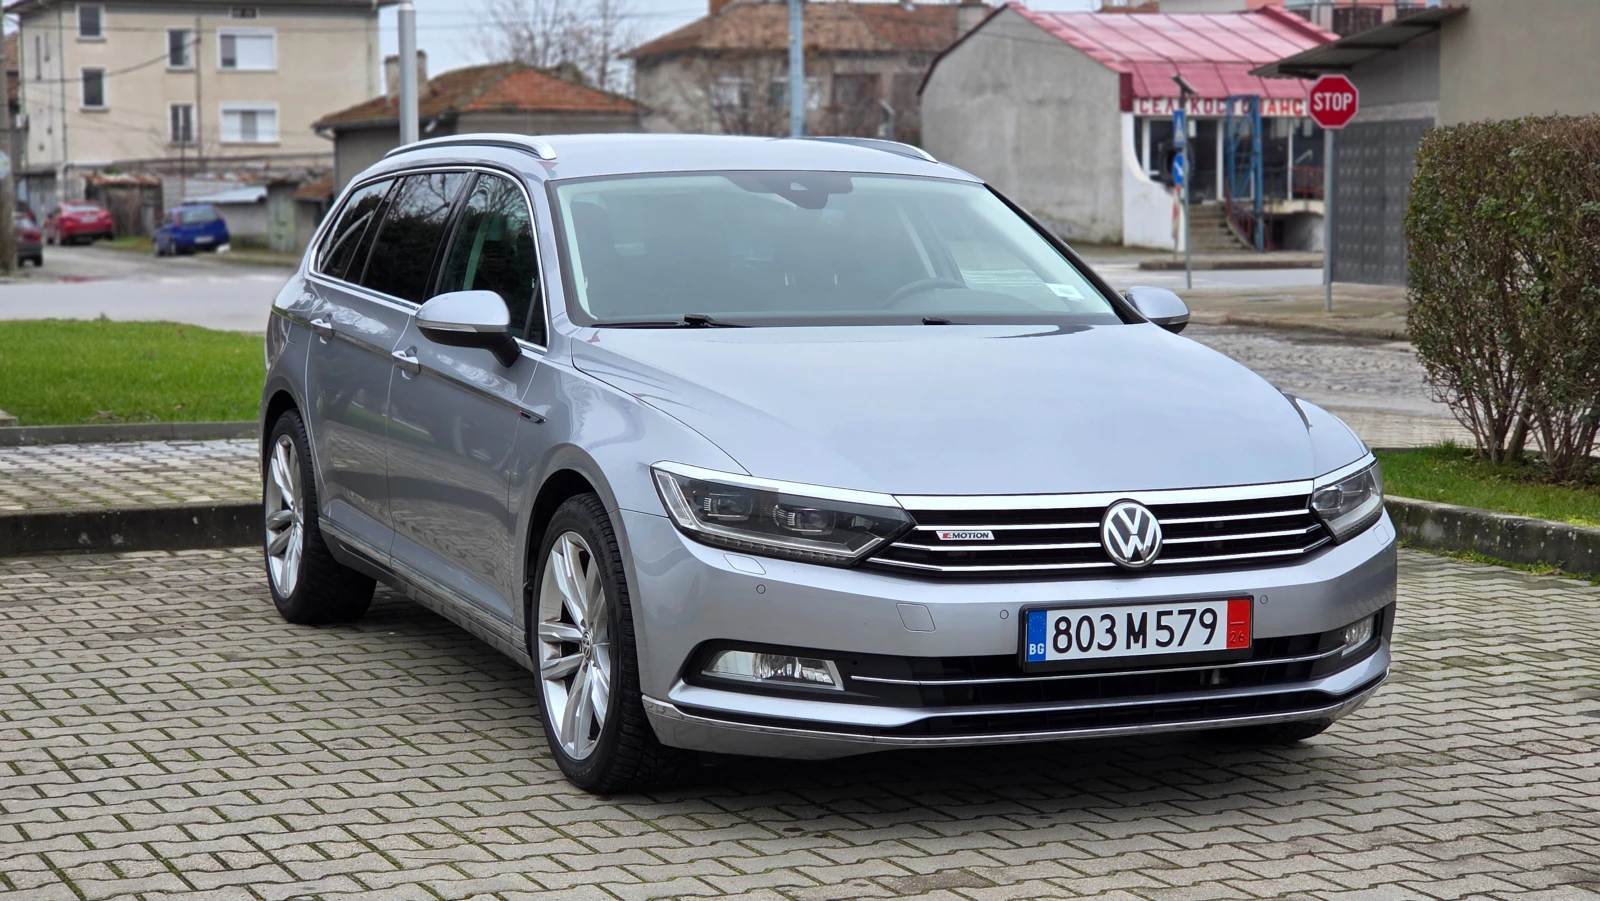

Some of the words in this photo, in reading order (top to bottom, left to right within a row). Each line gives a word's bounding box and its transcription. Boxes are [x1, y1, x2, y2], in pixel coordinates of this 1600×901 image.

[1313, 92, 1353, 112] STOP
[1103, 502, 1162, 566] VW
[1052, 613, 1118, 654] 803
[1125, 611, 1148, 650] M
[1155, 608, 1218, 648] 579
[1229, 630, 1246, 644] 26
[1029, 643, 1045, 656] BG
